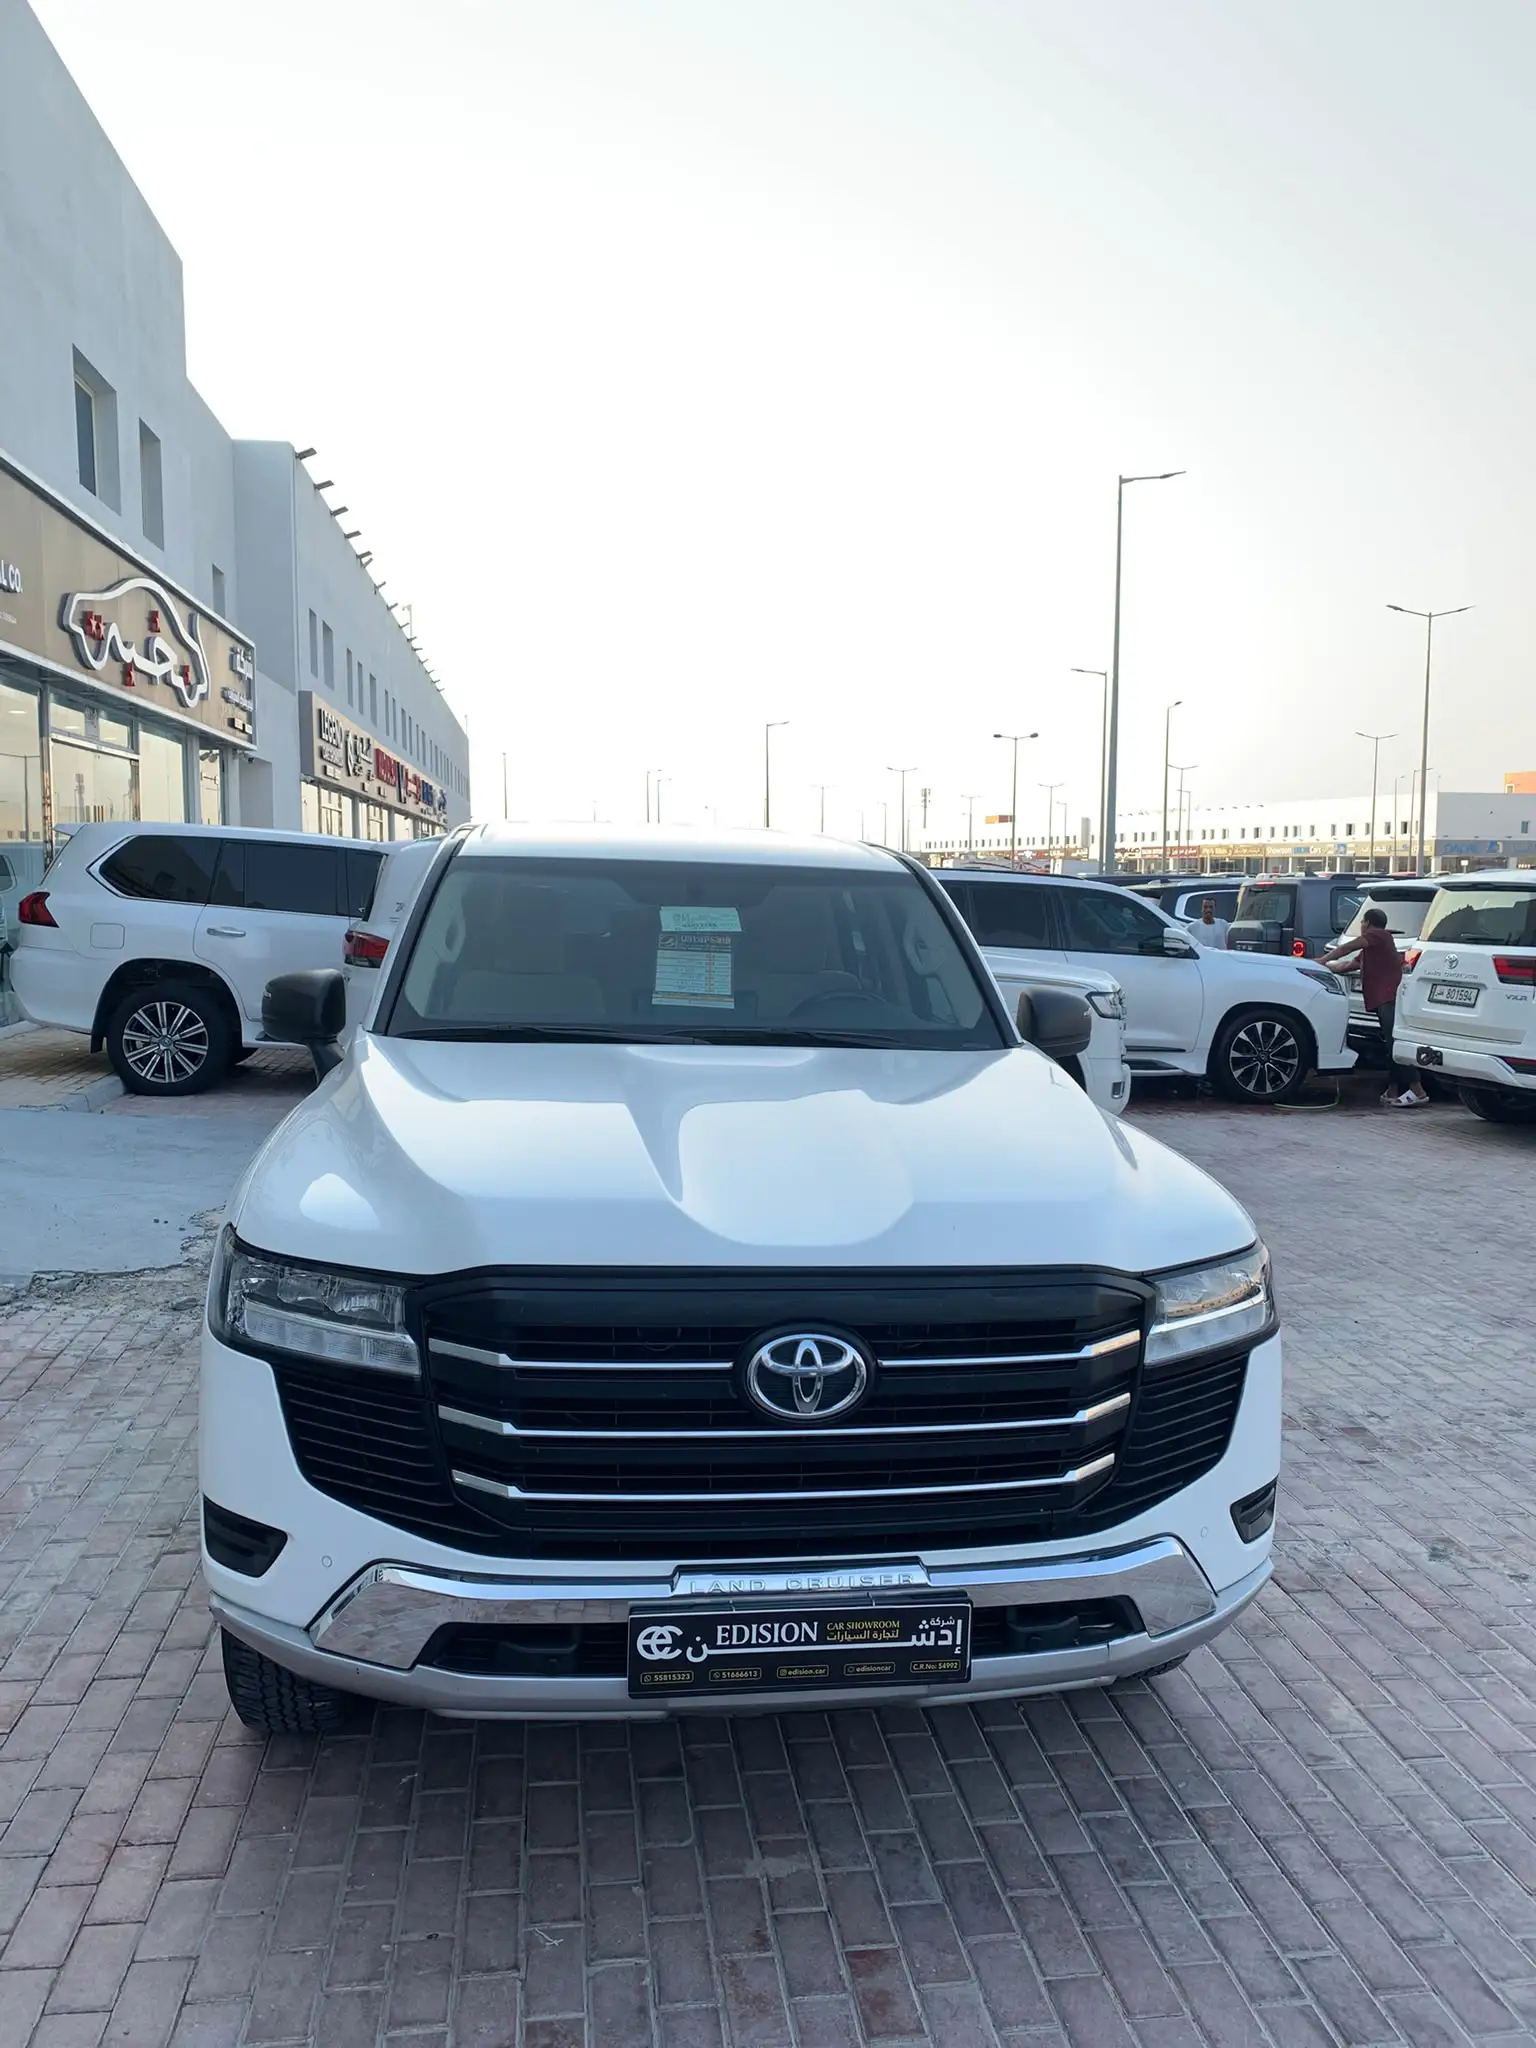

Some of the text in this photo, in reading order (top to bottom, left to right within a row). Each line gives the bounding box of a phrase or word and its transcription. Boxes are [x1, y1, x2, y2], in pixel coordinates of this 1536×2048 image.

[1446, 988, 1473, 1002] 801594
[690, 1573, 915, 1593] LAND CRUISER
[826, 1620, 900, 1631] CAR SHOWROOM
[715, 1621, 819, 1646] EDISION
[826, 1628, 899, 1642] لتجارة السيارات
[654, 1673, 691, 1682] 55815323
[721, 1670, 758, 1679] 51666613
